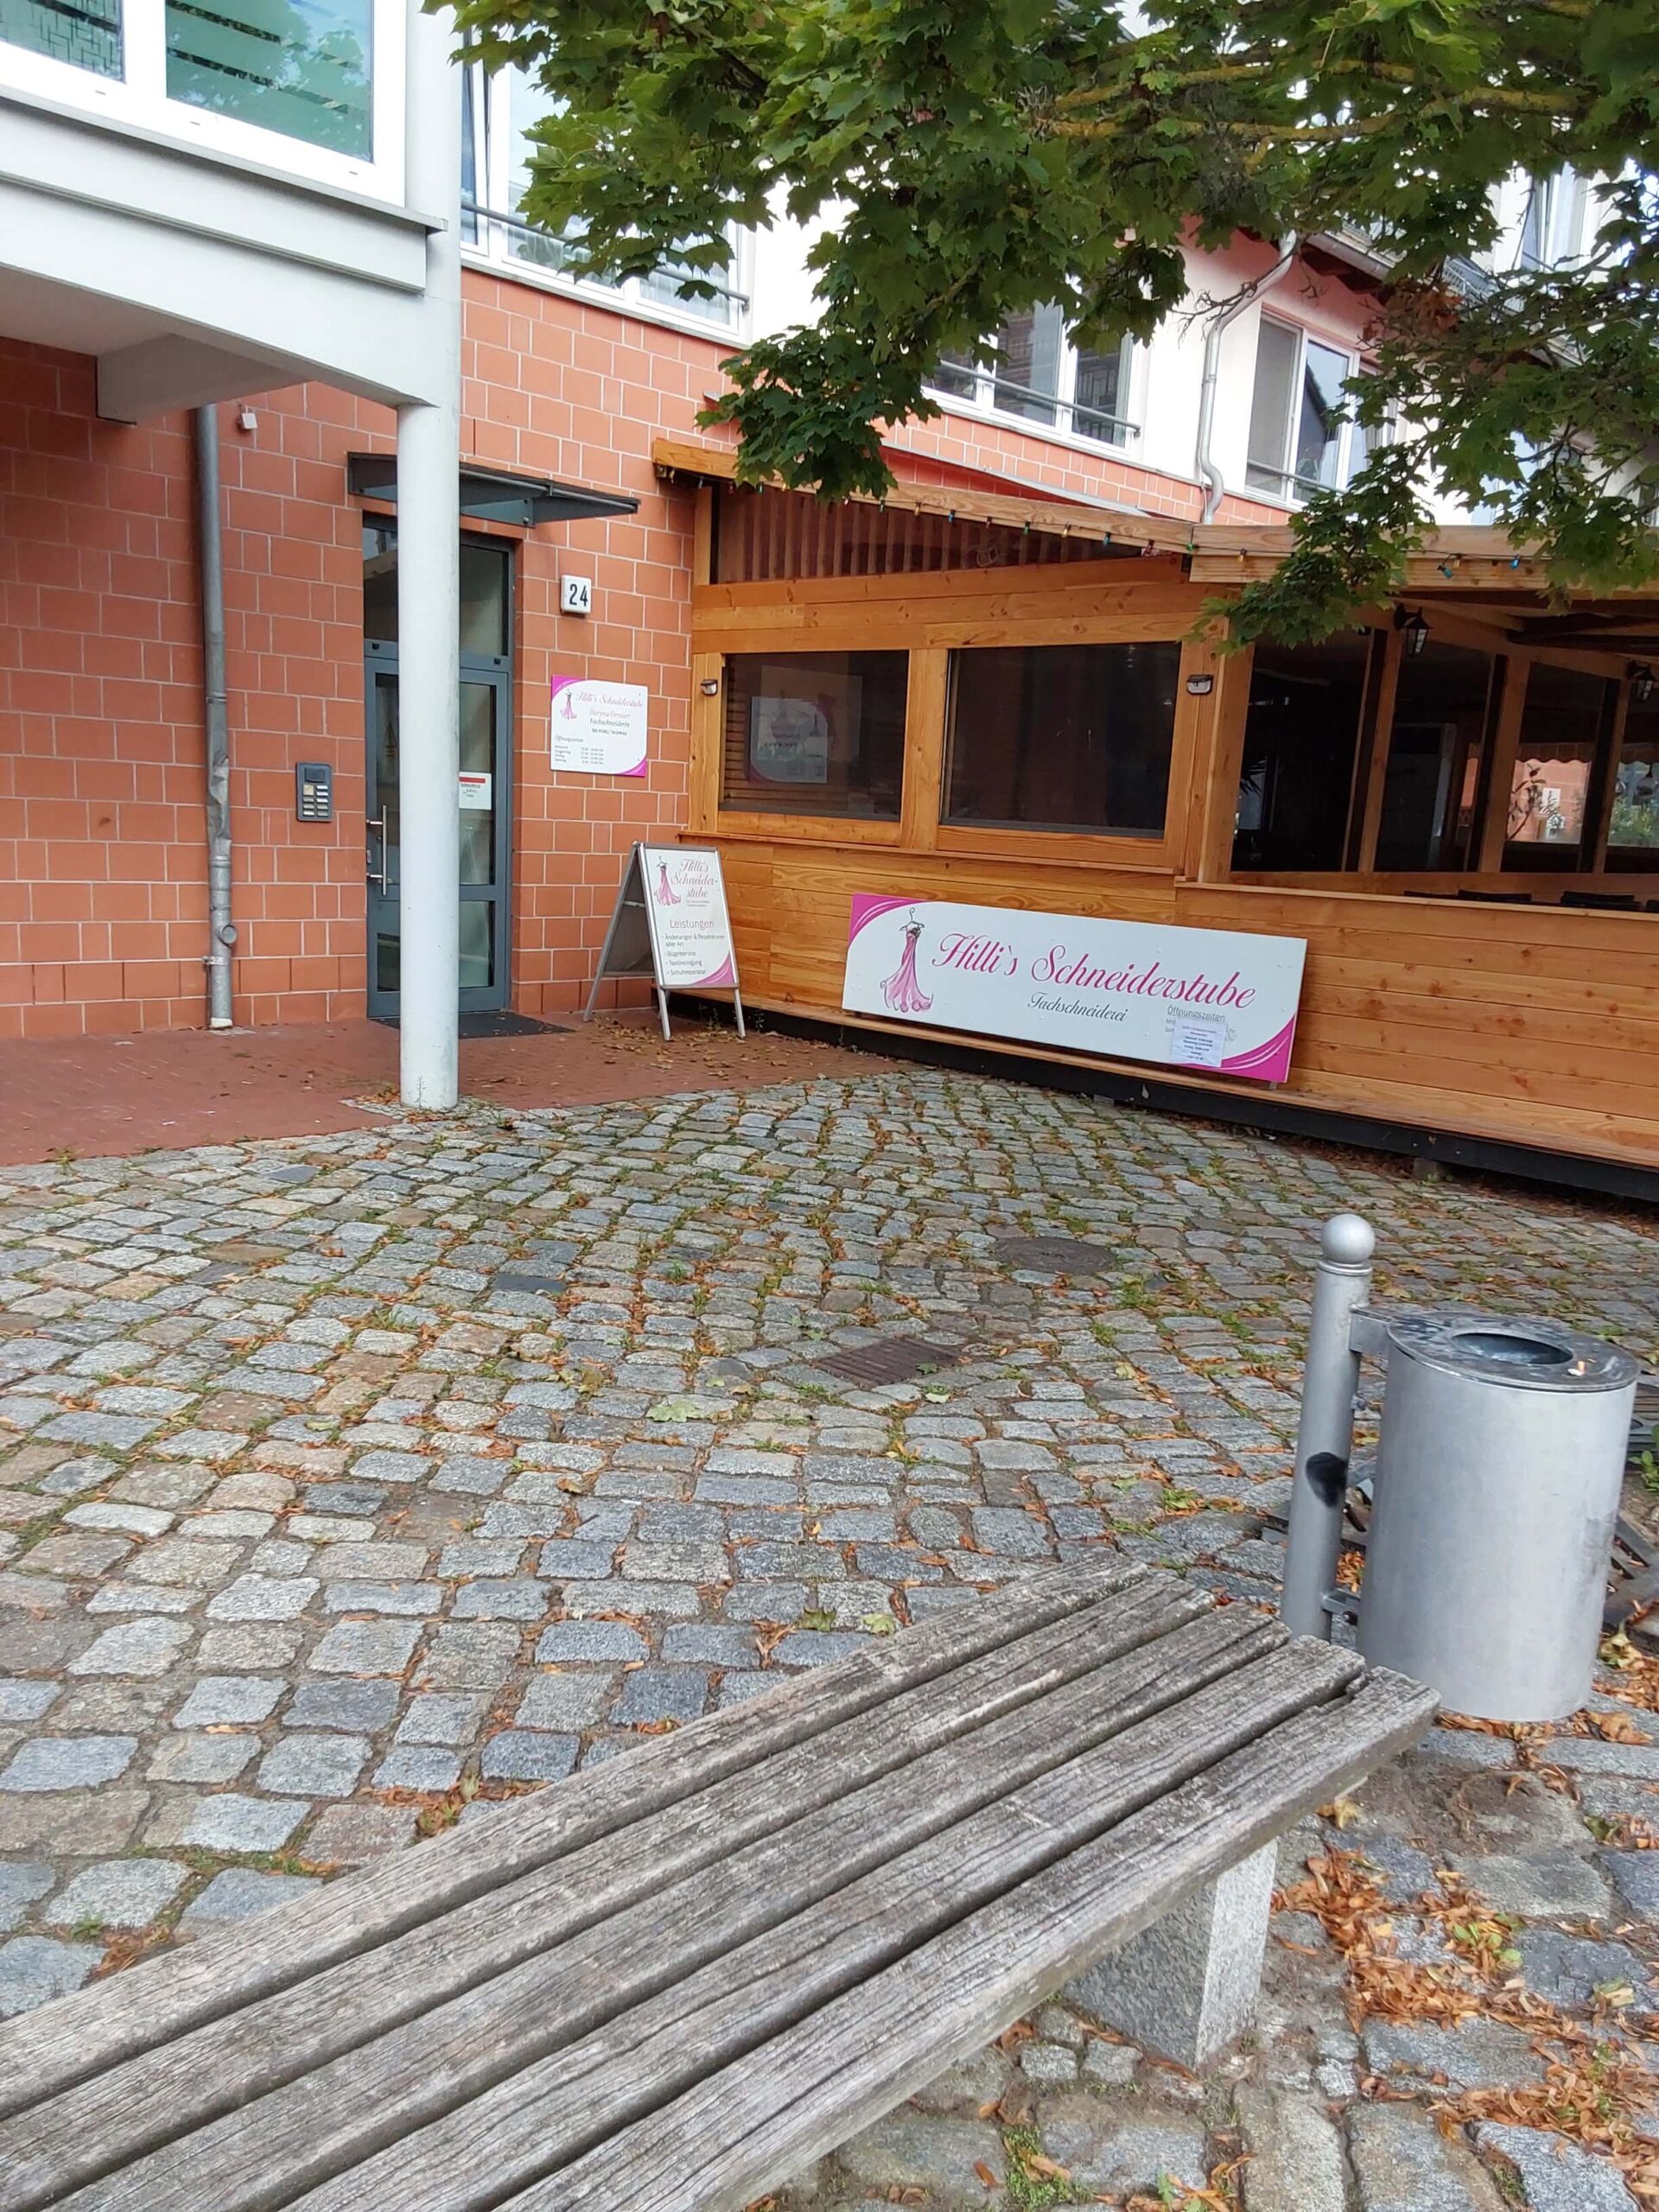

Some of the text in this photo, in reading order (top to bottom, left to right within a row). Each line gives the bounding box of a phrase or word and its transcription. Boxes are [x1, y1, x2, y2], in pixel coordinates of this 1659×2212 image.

[569, 583, 588, 607] 24
[589, 718, 630, 728] Fachschneiderin
[671, 872, 718, 886] Schneider-
[686, 887, 709, 898] stube
[670, 919, 715, 931] Leistungen
[1031, 944, 1256, 1009] Schneiderstube
[1027, 991, 1129, 1023] Fachschneiderei
[1167, 1004, 1225, 1022] Öffnungszeiten
